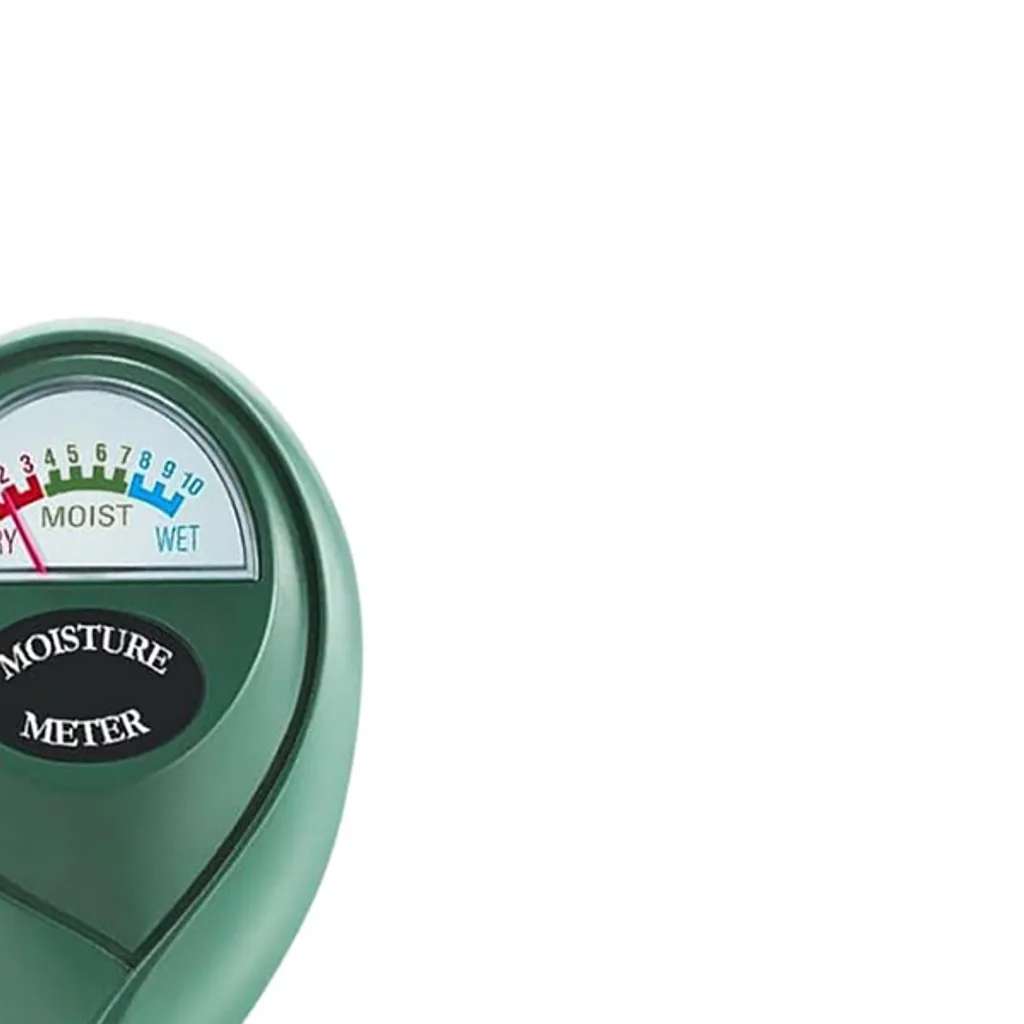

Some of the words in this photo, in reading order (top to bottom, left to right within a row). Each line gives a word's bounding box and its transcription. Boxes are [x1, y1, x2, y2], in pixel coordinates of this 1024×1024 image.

[19, 454, 35, 474] 3
[44, 448, 57, 466] 4
[66, 444, 79, 463] 5
[95, 443, 107, 462] 6
[120, 446, 132, 464] 7
[138, 451, 153, 470] 8
[161, 460, 177, 479] 9
[181, 472, 204, 496] 10
[41, 504, 134, 528] MOIST
[156, 525, 200, 552] WET
[19, 708, 152, 747] METER
